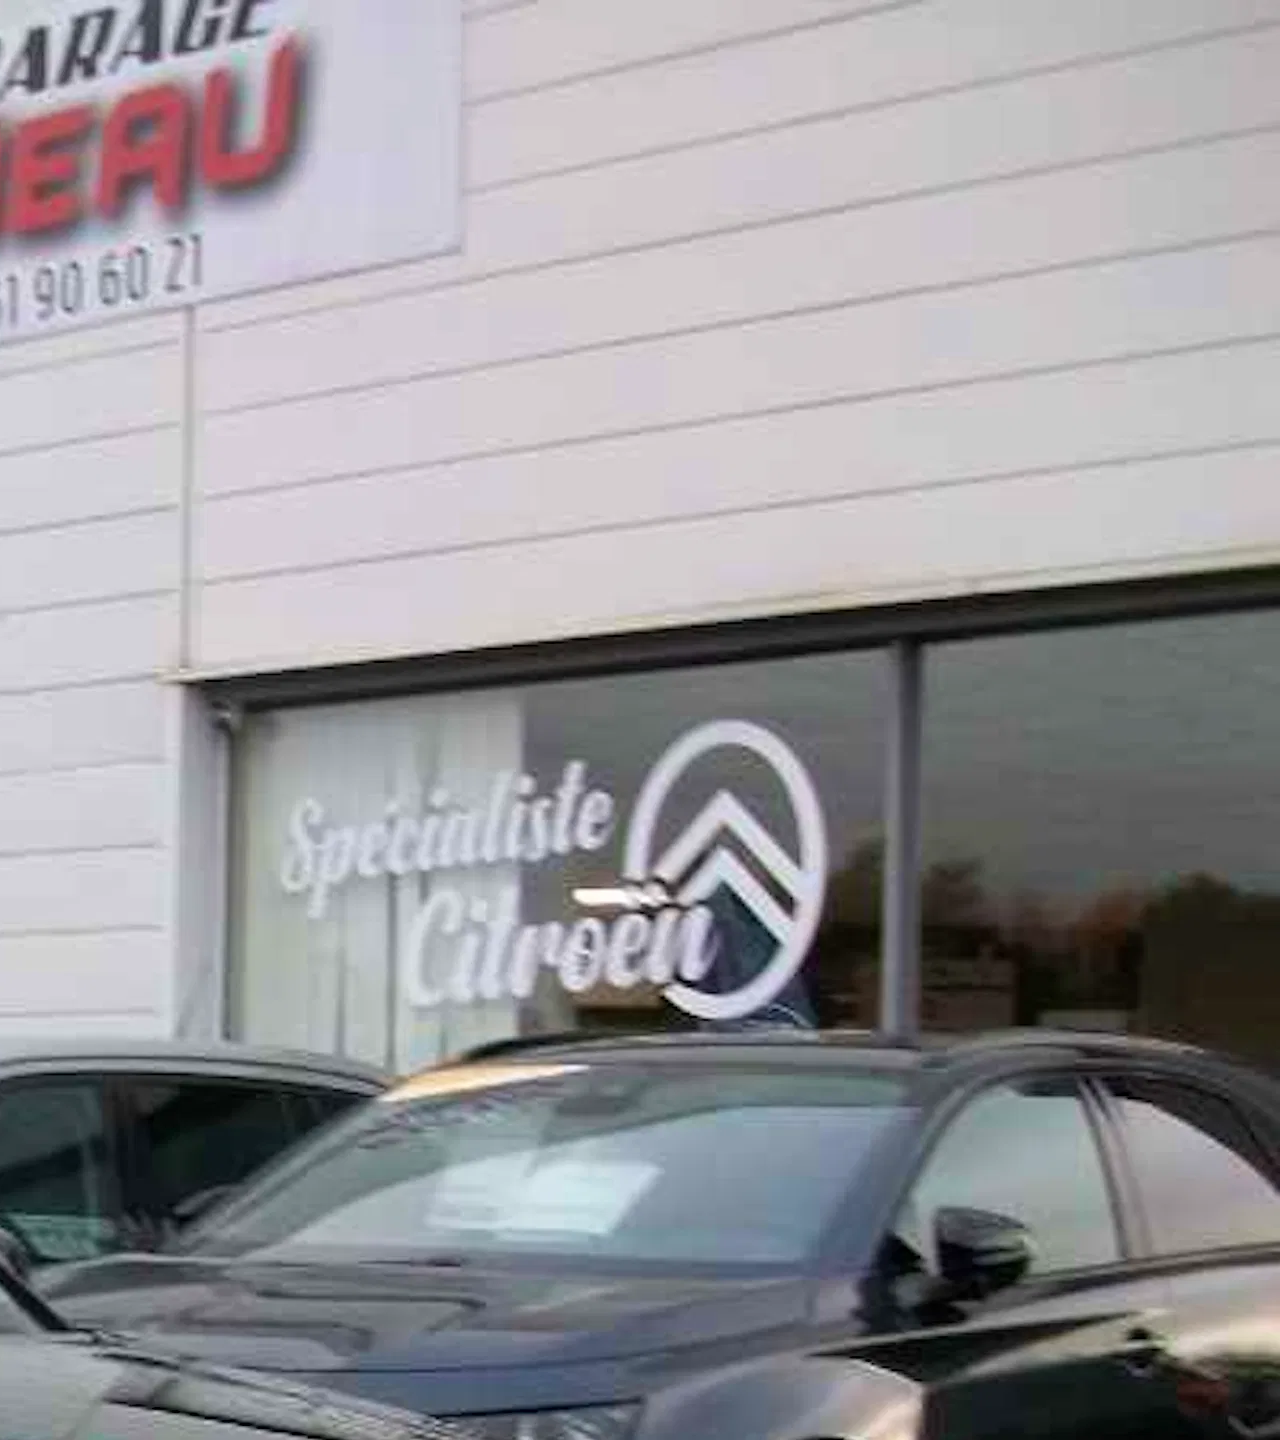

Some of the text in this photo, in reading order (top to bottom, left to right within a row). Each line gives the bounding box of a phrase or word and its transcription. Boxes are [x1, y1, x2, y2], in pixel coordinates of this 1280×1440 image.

[34, 257, 85, 320] 90
[98, 244, 150, 306] 60
[163, 232, 203, 294] 21
